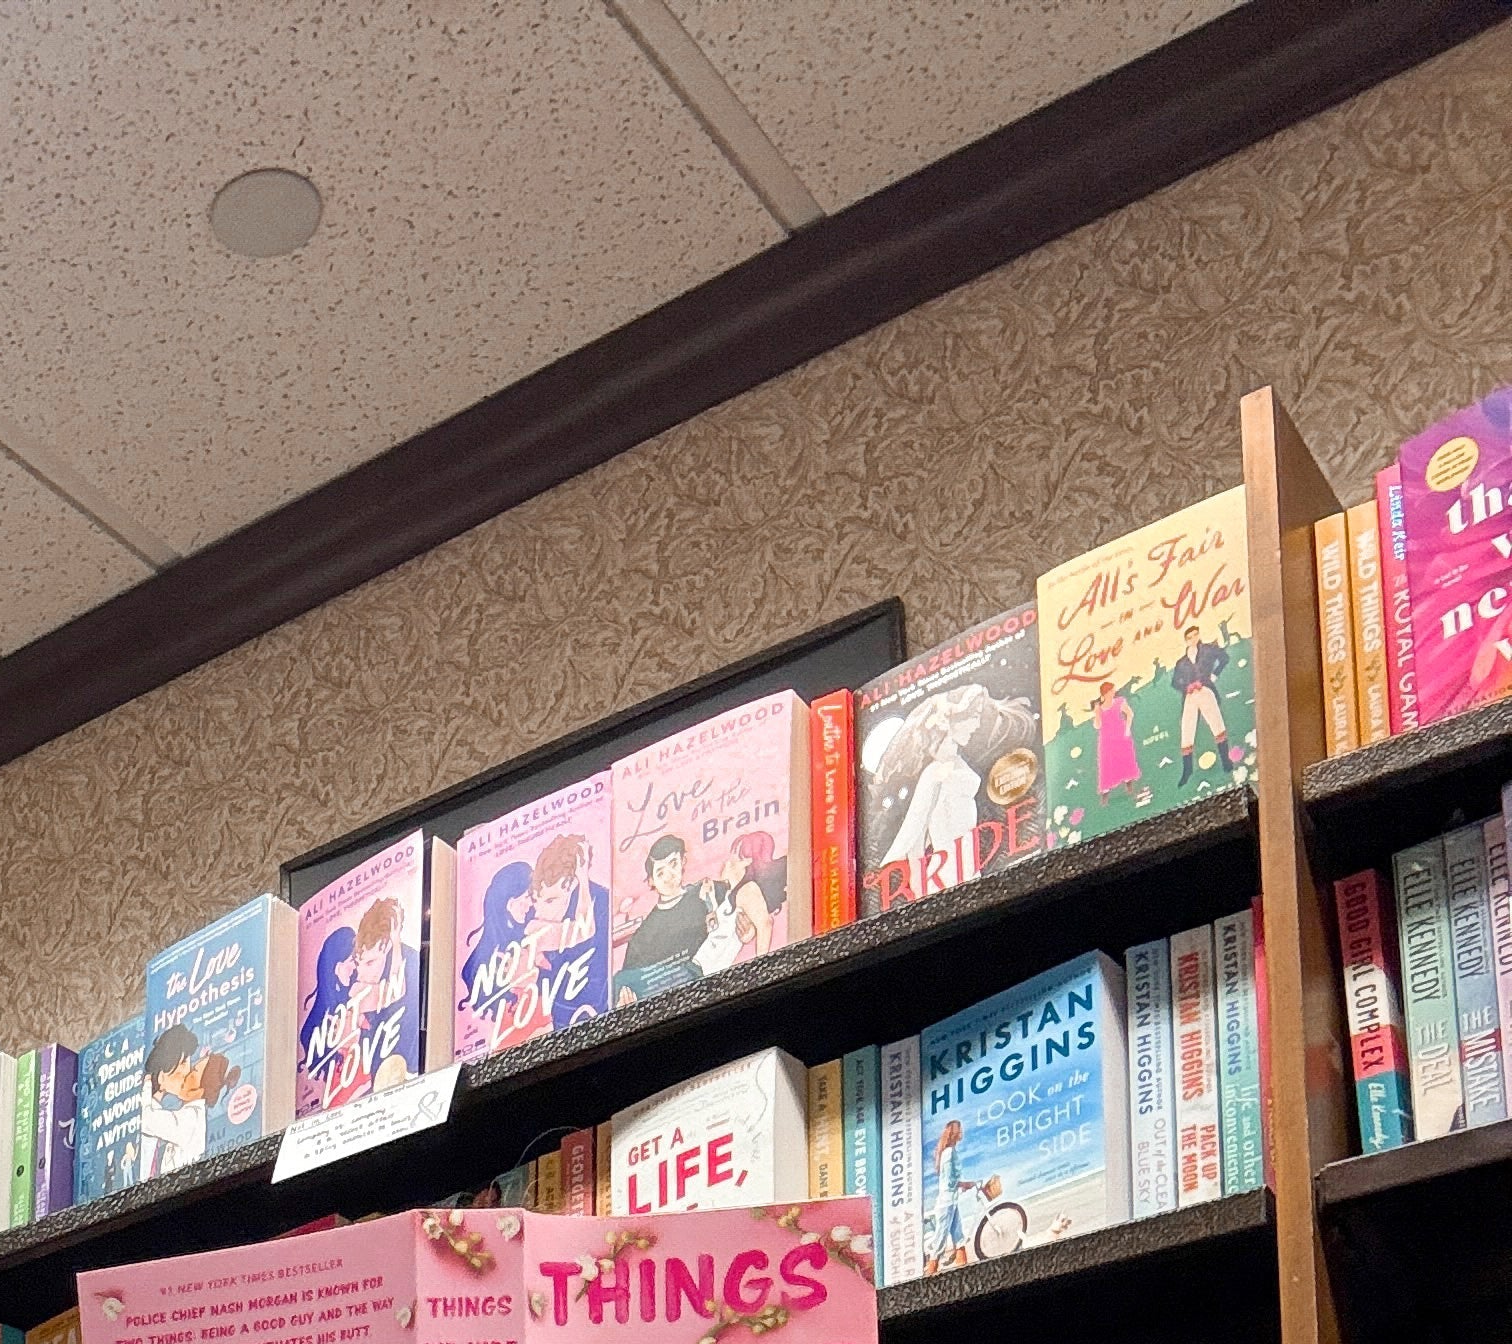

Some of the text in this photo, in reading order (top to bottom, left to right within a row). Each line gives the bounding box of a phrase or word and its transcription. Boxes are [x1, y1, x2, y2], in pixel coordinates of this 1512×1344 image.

[1058, 528, 1224, 630] All's Fair
[861, 610, 1037, 709] ALI HAZELWOOD
[1051, 633, 1123, 695] Love
[1161, 564, 1245, 630] War
[622, 703, 783, 779] ALI HAZELWOOD
[468, 782, 604, 853] ALI HAZELWOOD
[619, 777, 713, 852] Love
[703, 800, 779, 843] Brain
[863, 797, 1039, 912] BRIDE
[166, 941, 241, 999] the Love
[470, 897, 595, 1003] NOT IN
[154, 967, 254, 1033] Hypothesis
[490, 947, 595, 1051] LOVE
[930, 984, 1093, 1080] KRISTAN
[931, 1021, 1095, 1115] HIGGINS
[977, 1070, 1089, 1126] LOOK on the
[629, 1127, 684, 1166] GET A
[997, 1095, 1084, 1147] BRIGHT
[1039, 1122, 1092, 1159] SIDE
[629, 1133, 748, 1215] LIFE,
[427, 1295, 513, 1318] THINGS
[539, 1242, 828, 1327] THINGS
